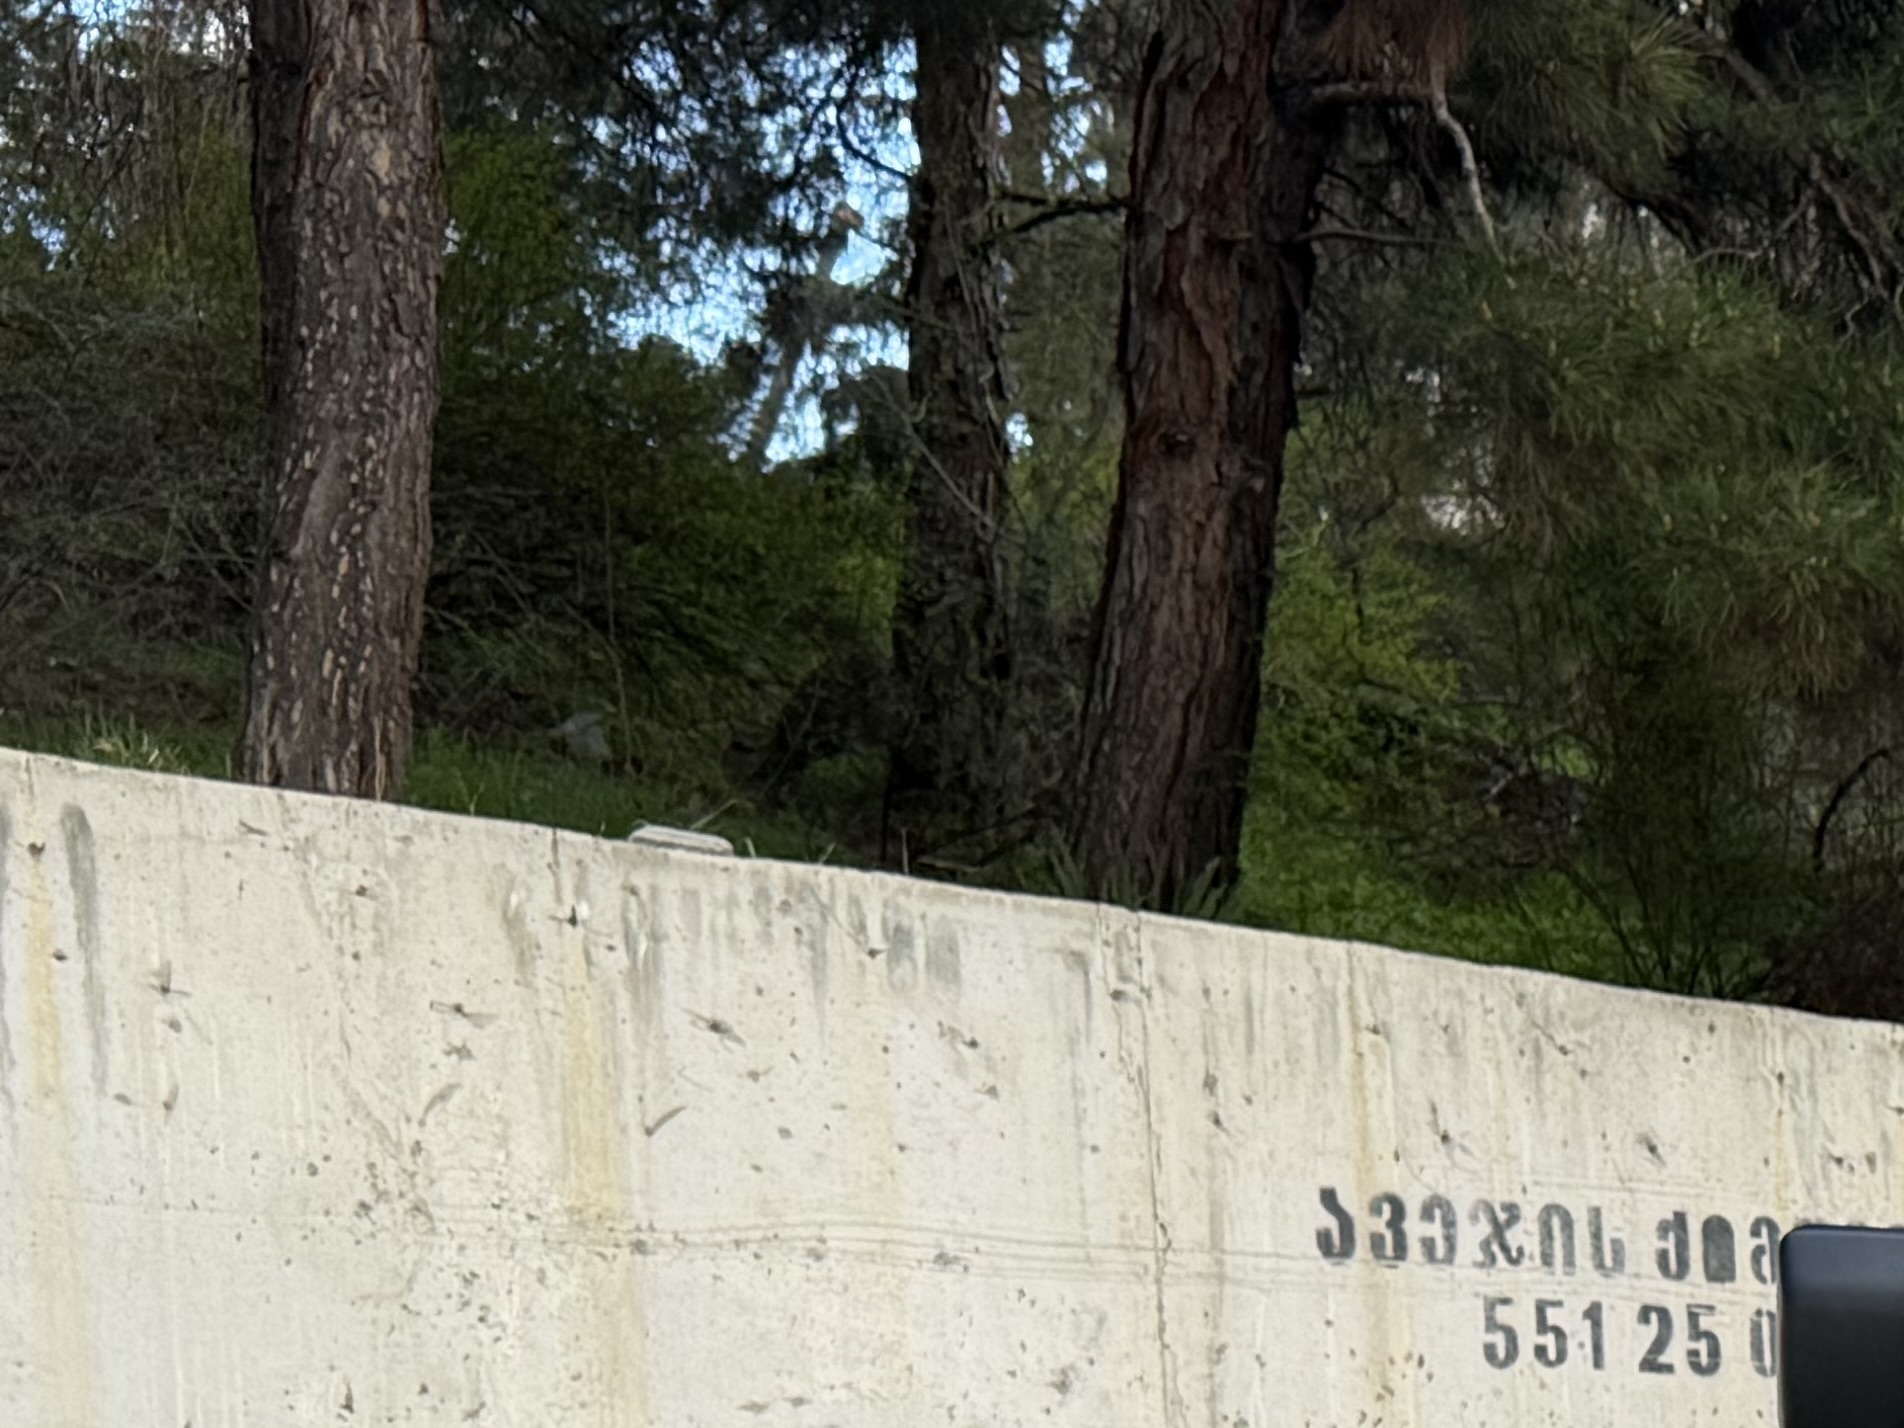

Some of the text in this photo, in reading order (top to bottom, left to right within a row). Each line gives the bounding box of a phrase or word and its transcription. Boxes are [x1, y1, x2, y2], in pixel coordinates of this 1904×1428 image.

[1315, 1186, 1626, 1278] ავეჯის
[1482, 1295, 1605, 1371] 551
[1637, 1303, 1723, 1377] 25
